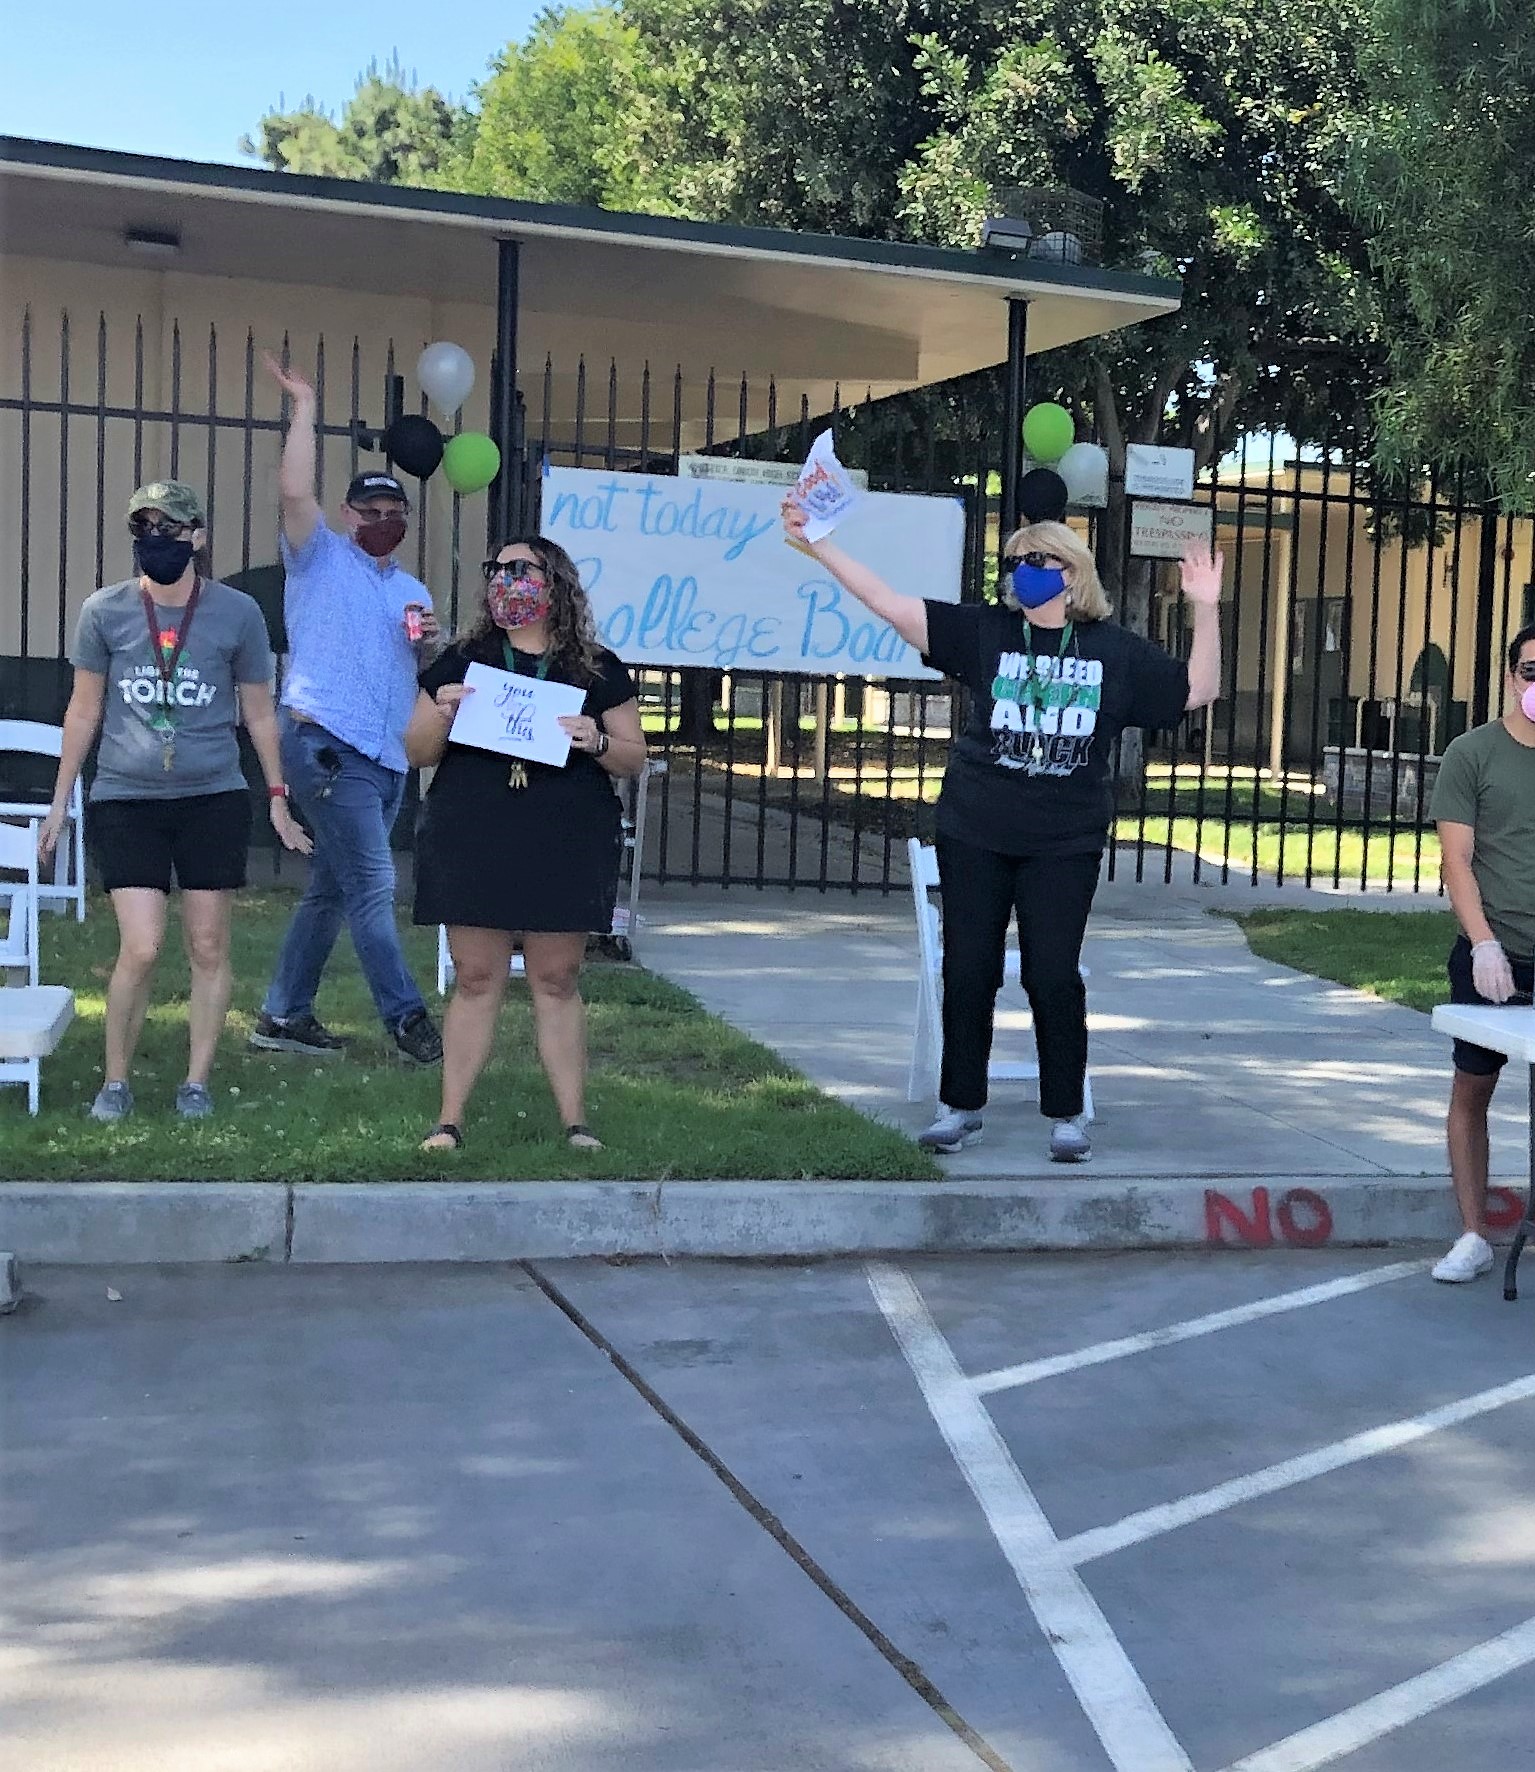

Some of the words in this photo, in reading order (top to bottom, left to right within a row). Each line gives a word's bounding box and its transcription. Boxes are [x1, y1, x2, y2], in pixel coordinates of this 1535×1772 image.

[551, 480, 629, 532] not
[638, 481, 776, 561] today
[575, 557, 781, 664] ollege
[797, 580, 908, 662] Boa
[1205, 1187, 1333, 1247] NO
